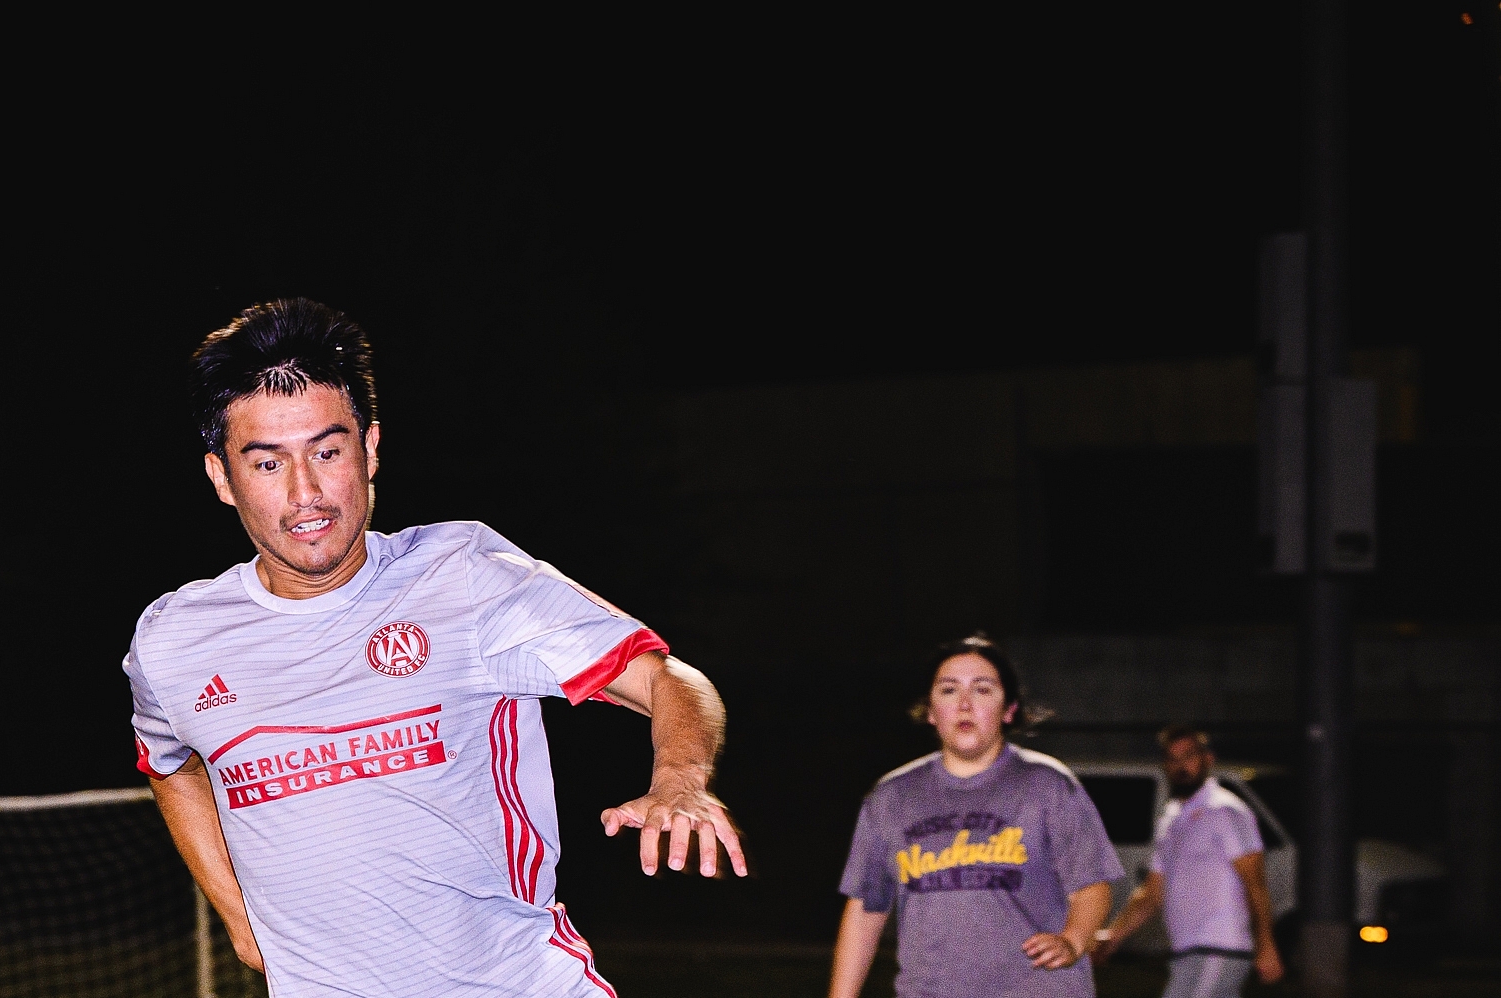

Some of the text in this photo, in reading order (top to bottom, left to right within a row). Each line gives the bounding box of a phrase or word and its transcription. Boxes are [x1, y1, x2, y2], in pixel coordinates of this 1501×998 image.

[372, 623, 415, 643] ATLANTA
[378, 654, 426, 676] UNITED FC
[194, 693, 237, 713] adidas
[218, 719, 440, 786] AMERICAN FAMILY
[236, 751, 430, 804] INSURANCE
